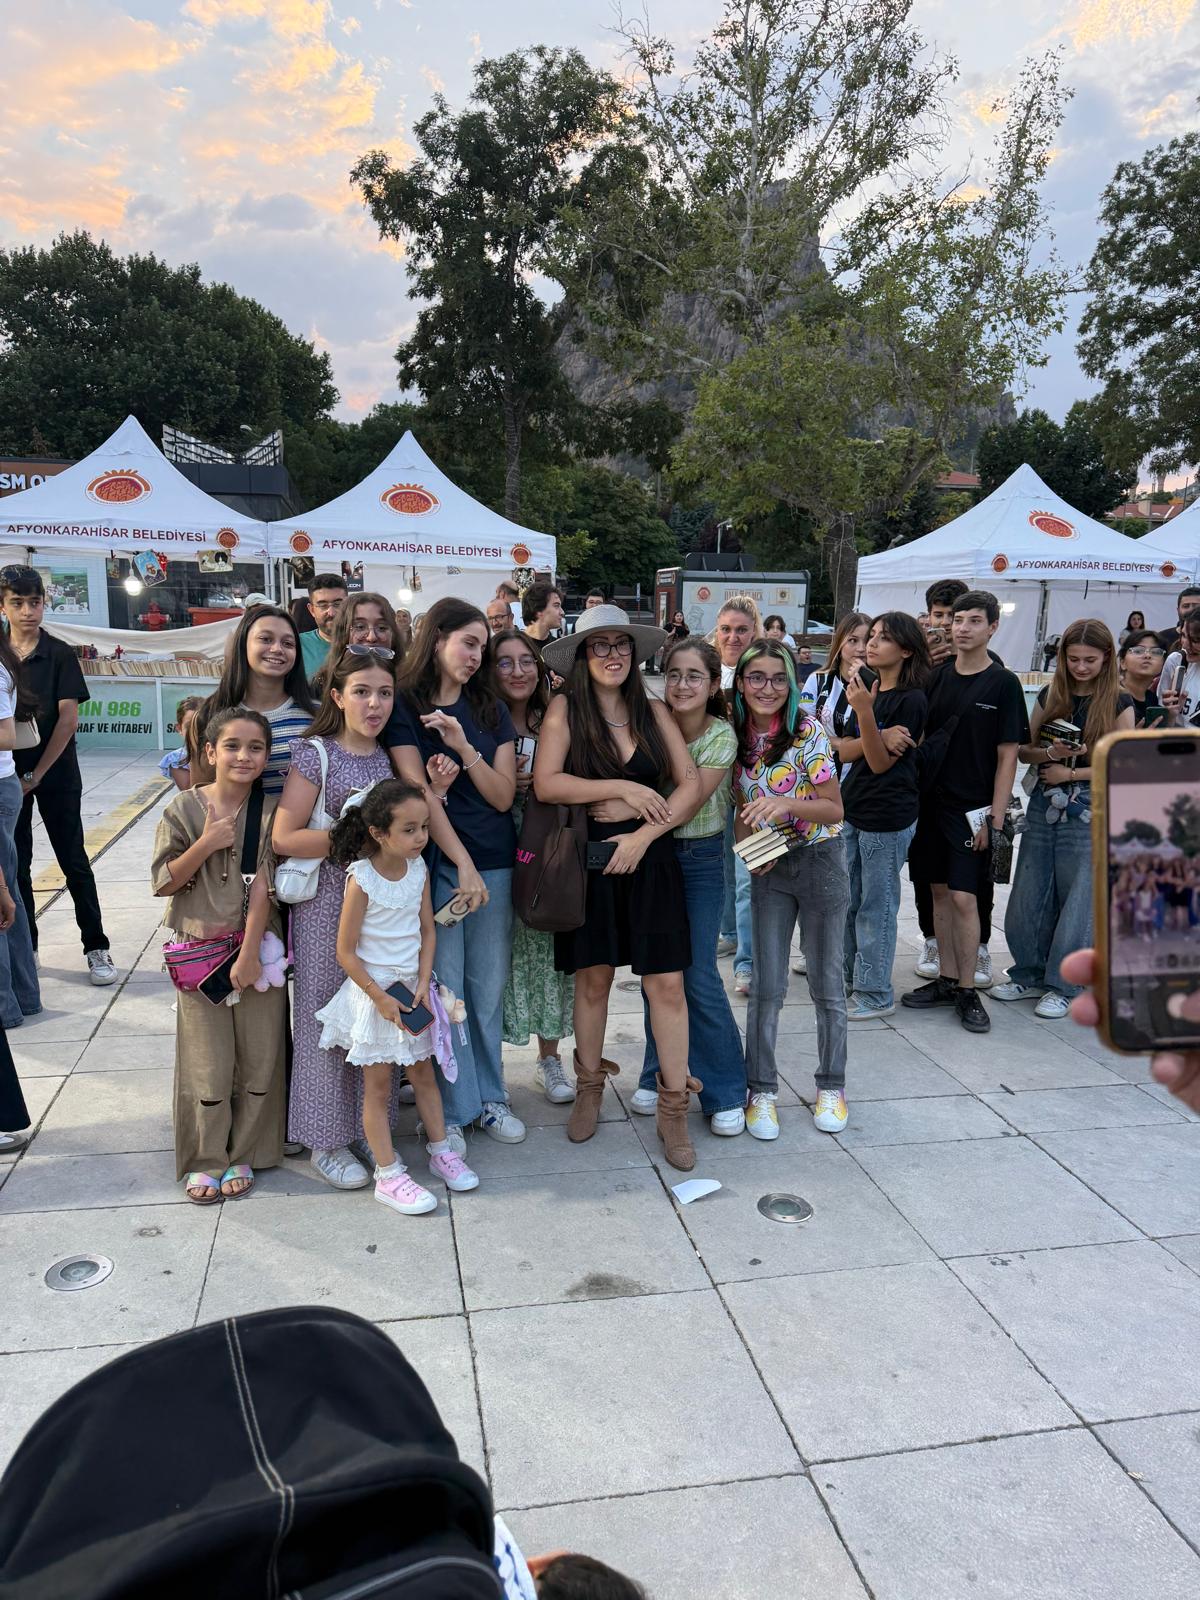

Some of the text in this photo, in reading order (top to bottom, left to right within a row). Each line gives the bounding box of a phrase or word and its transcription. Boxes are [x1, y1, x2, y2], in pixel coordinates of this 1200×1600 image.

[7, 524, 206, 542] AFYONKARAHİSAR BELEDİYESİ
[322, 540, 502, 558] AFYONKARAHİSAR BELEDİYESİ
[1016, 559, 1154, 572] AFYONKARAHİSAR BELEDİYESİ
[107, 701, 142, 717] 986
[98, 722, 109, 733] VE
[111, 721, 153, 733] KİTABEVİ
